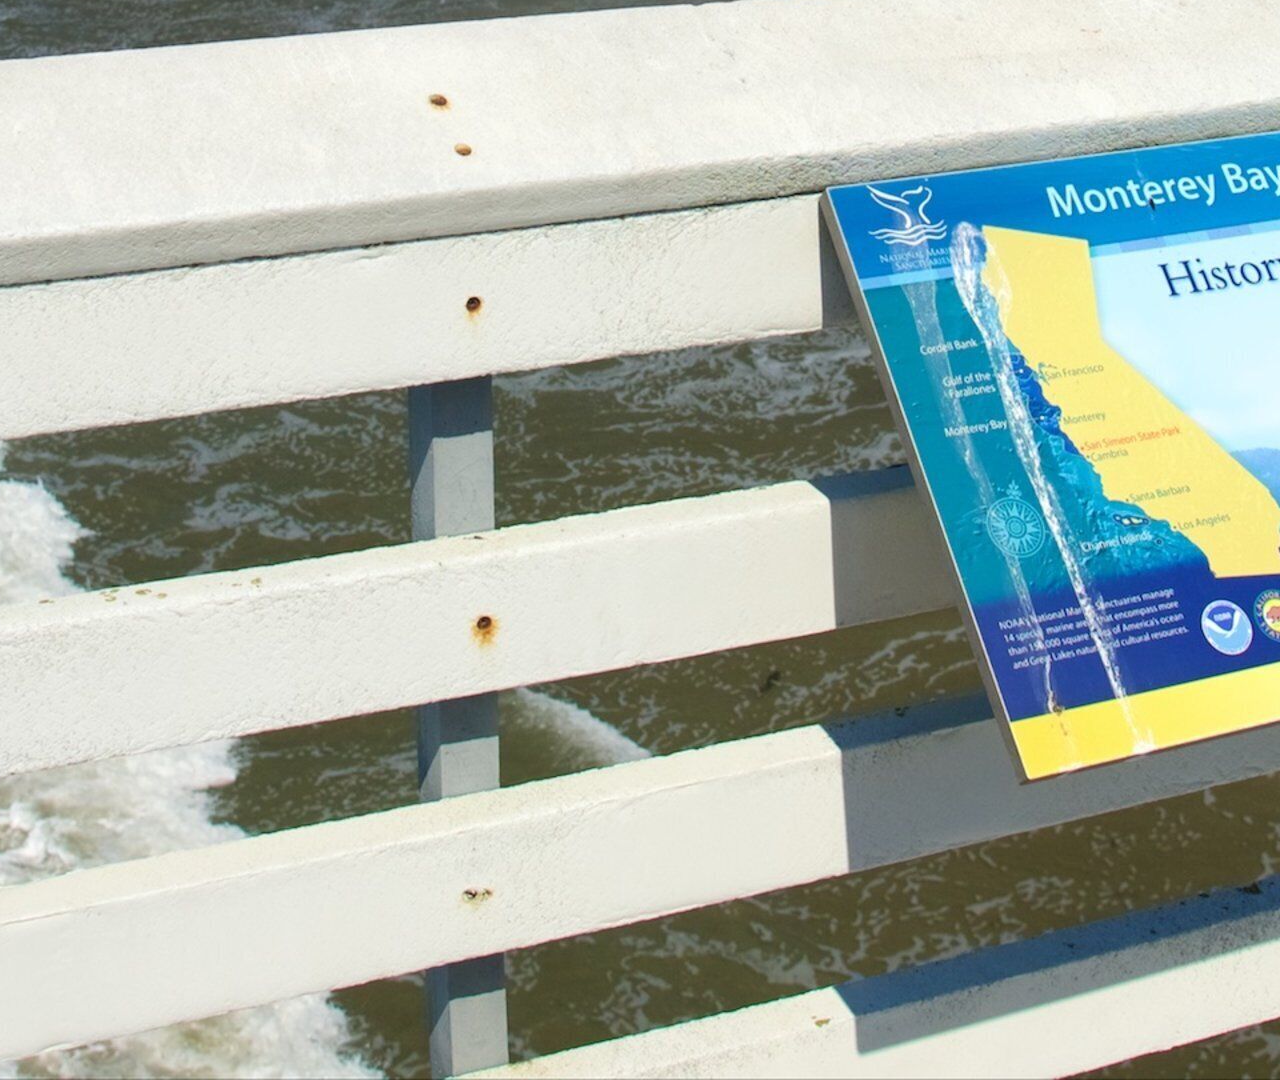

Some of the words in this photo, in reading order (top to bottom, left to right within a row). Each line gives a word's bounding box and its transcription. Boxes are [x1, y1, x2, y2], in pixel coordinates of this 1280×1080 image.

[1045, 169, 1220, 222] Monterey
[918, 340, 954, 356] Cordell
[953, 337, 978, 350] Bank
[941, 374, 963, 387] Gulf
[963, 372, 974, 383] of
[974, 371, 991, 381] the
[1045, 370, 1062, 379] San
[1061, 363, 1105, 377] Francisco
[943, 421, 990, 438] Monterey
[988, 418, 1007, 430] Bay
[1061, 409, 1108, 428] Monterey
[1084, 440, 1103, 451] San
[1101, 434, 1137, 447] Simeon
[1136, 429, 1161, 441] State
[1160, 425, 1181, 437] Park
[1089, 446, 1129, 463] Cambria
[1129, 491, 1156, 501] Santa
[1155, 483, 1191, 498] Barbara
[1176, 519, 1194, 531] Los
[1194, 512, 1231, 528] Angeles
